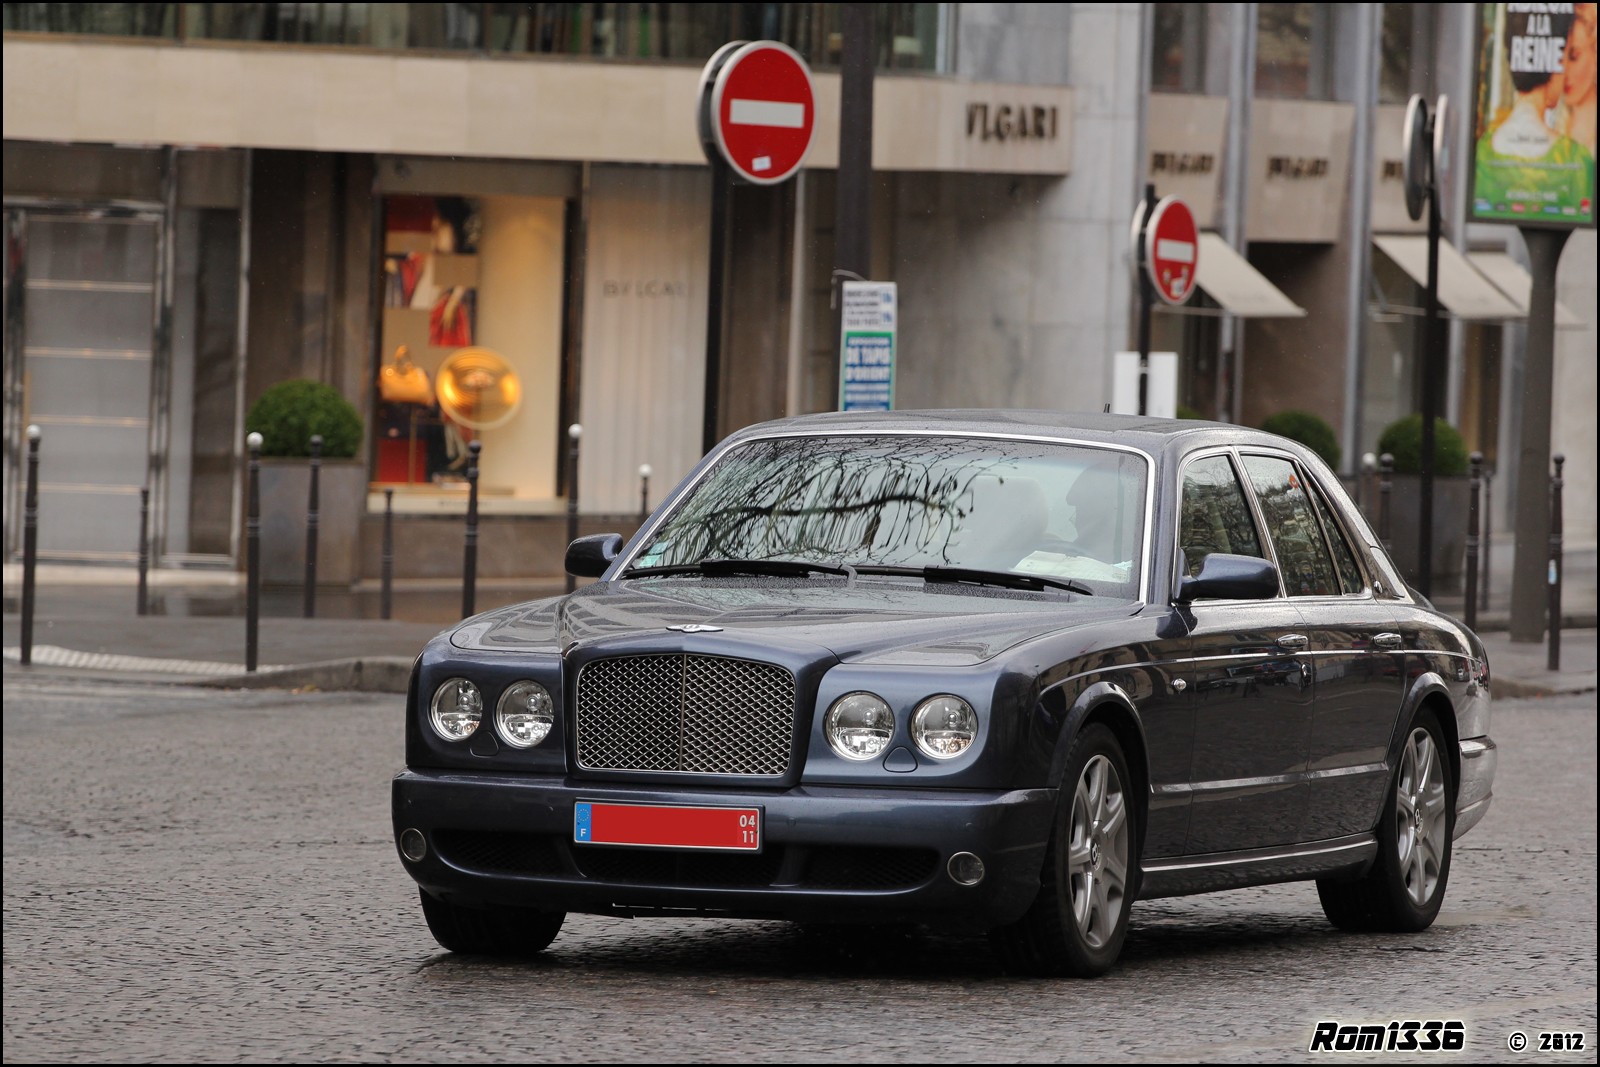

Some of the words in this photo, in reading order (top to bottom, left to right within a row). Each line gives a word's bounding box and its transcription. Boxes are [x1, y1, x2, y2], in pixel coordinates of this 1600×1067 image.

[1510, 36, 1566, 73] REINE
[739, 814, 756, 828] 04
[580, 828, 587, 837] F
